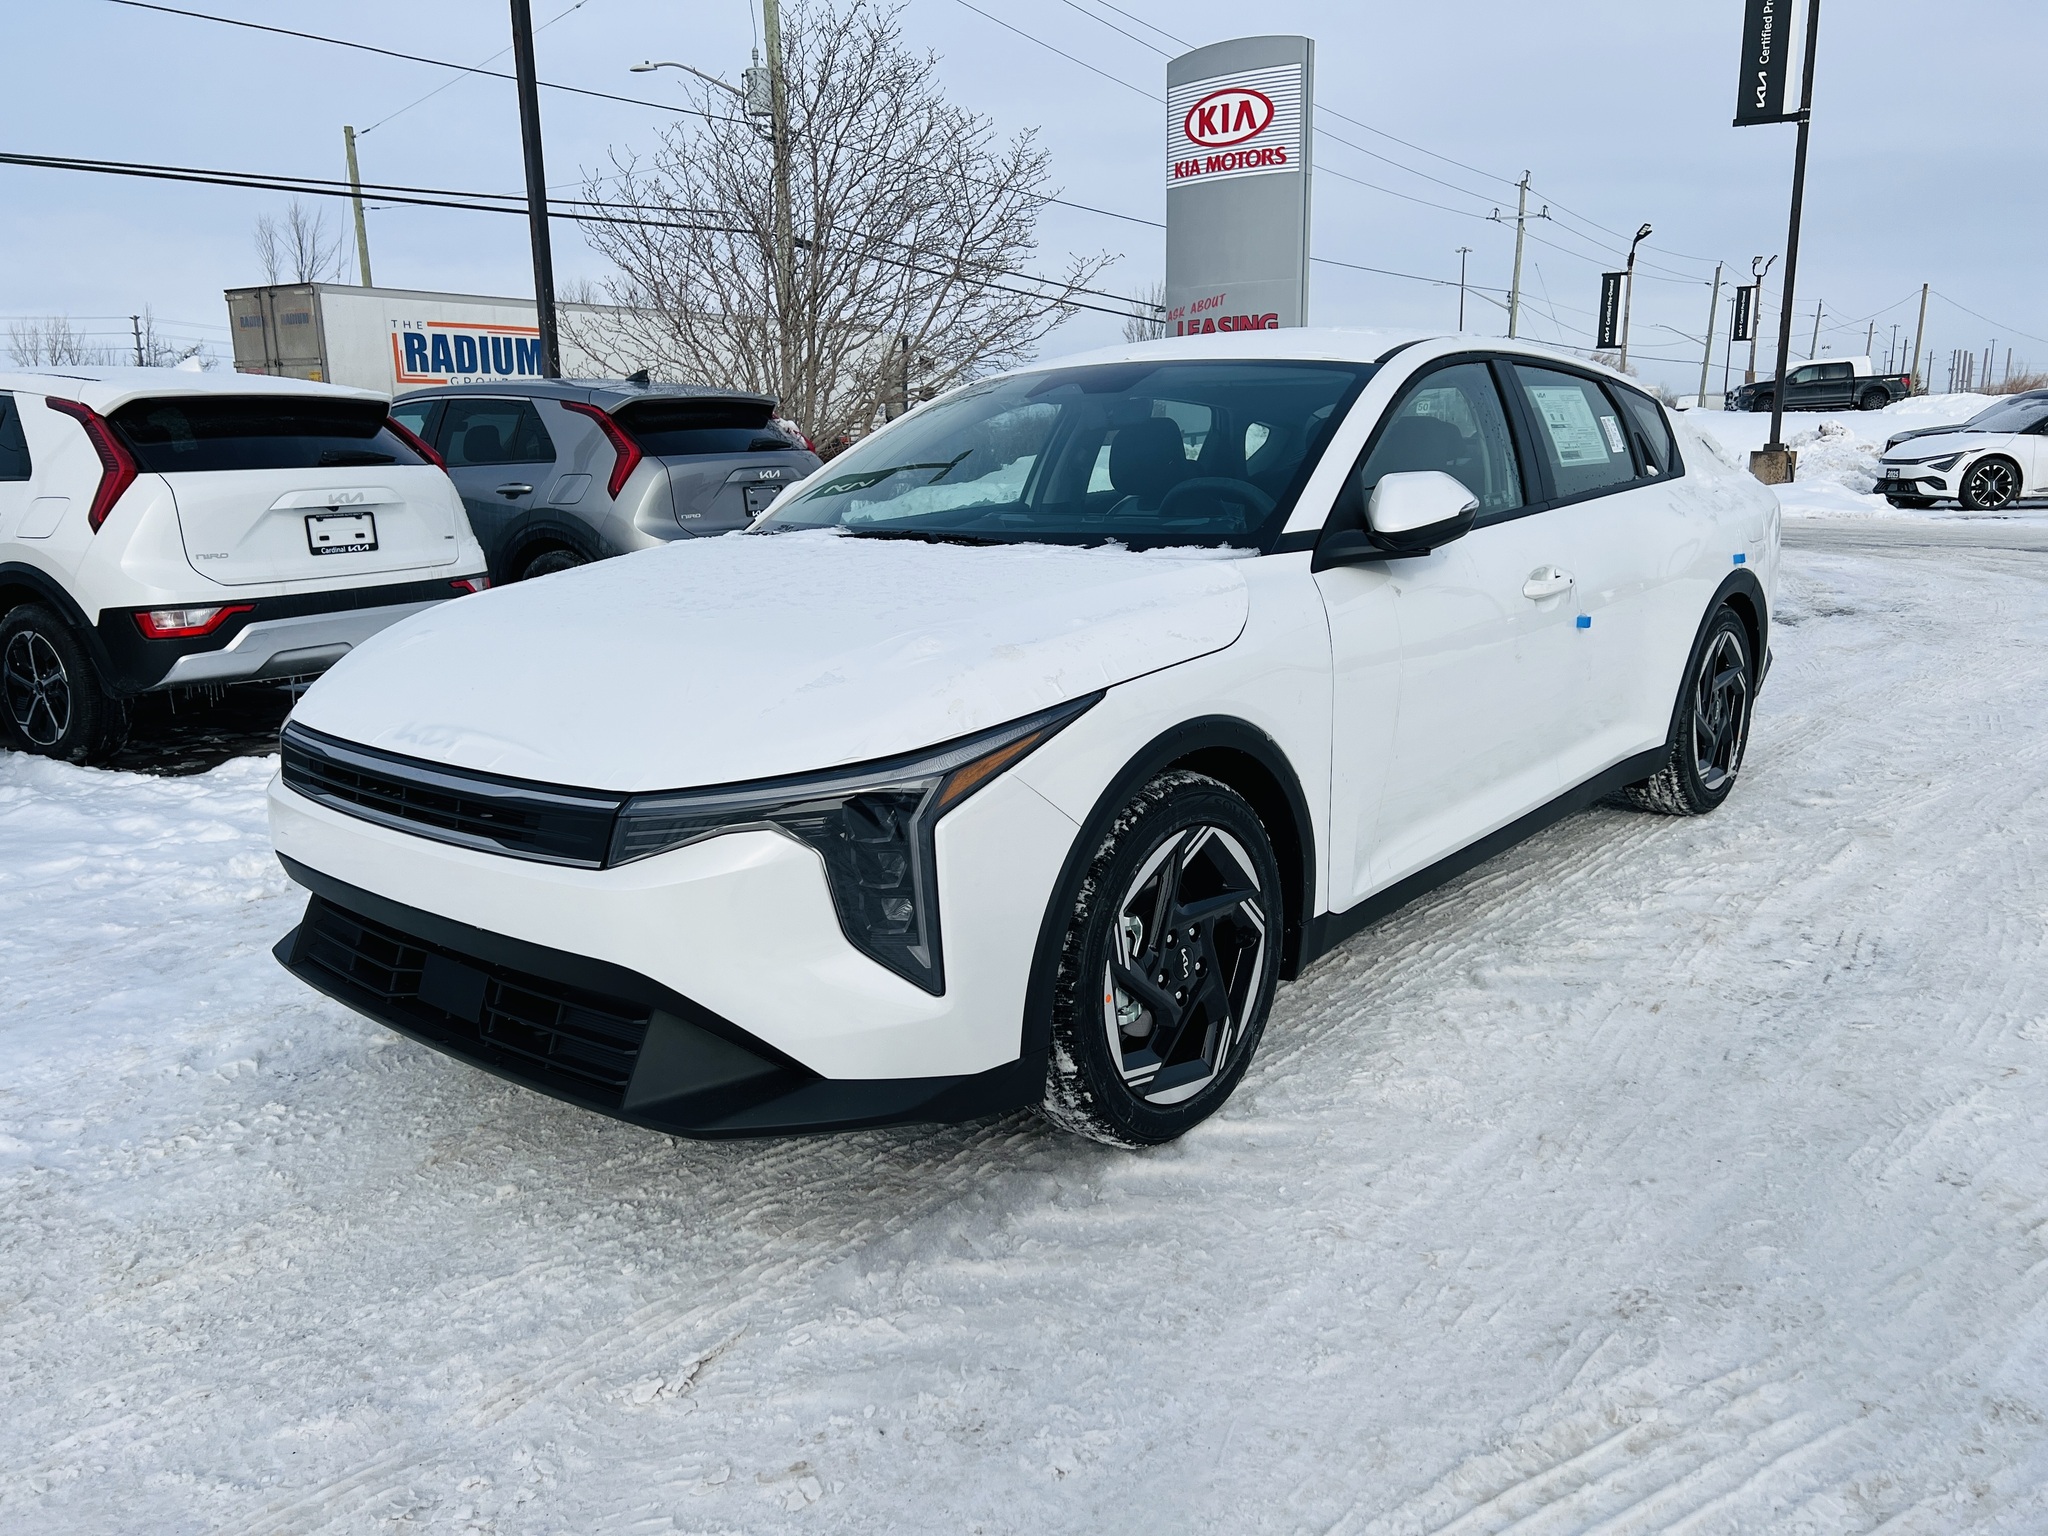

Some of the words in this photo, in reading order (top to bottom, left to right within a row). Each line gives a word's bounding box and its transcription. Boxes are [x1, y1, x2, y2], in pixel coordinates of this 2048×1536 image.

[1759, 16, 1773, 64] Certified
[1756, 71, 1767, 107] KIA
[1198, 100, 1257, 137] KIA
[1174, 159, 1200, 179] KIA
[1206, 146, 1287, 173] MOTORS
[1167, 306, 1185, 322] ASK
[1190, 293, 1226, 314] ABOUT
[391, 320, 423, 330] THE
[1177, 313, 1279, 336] LEASING
[403, 332, 542, 375] RADIUM
[1417, 403, 1429, 411] 50
[759, 470, 780, 478] KIA
[328, 492, 364, 504] KIA
[347, 544, 369, 552] KIA
[1181, 948, 1189, 978] KIA
